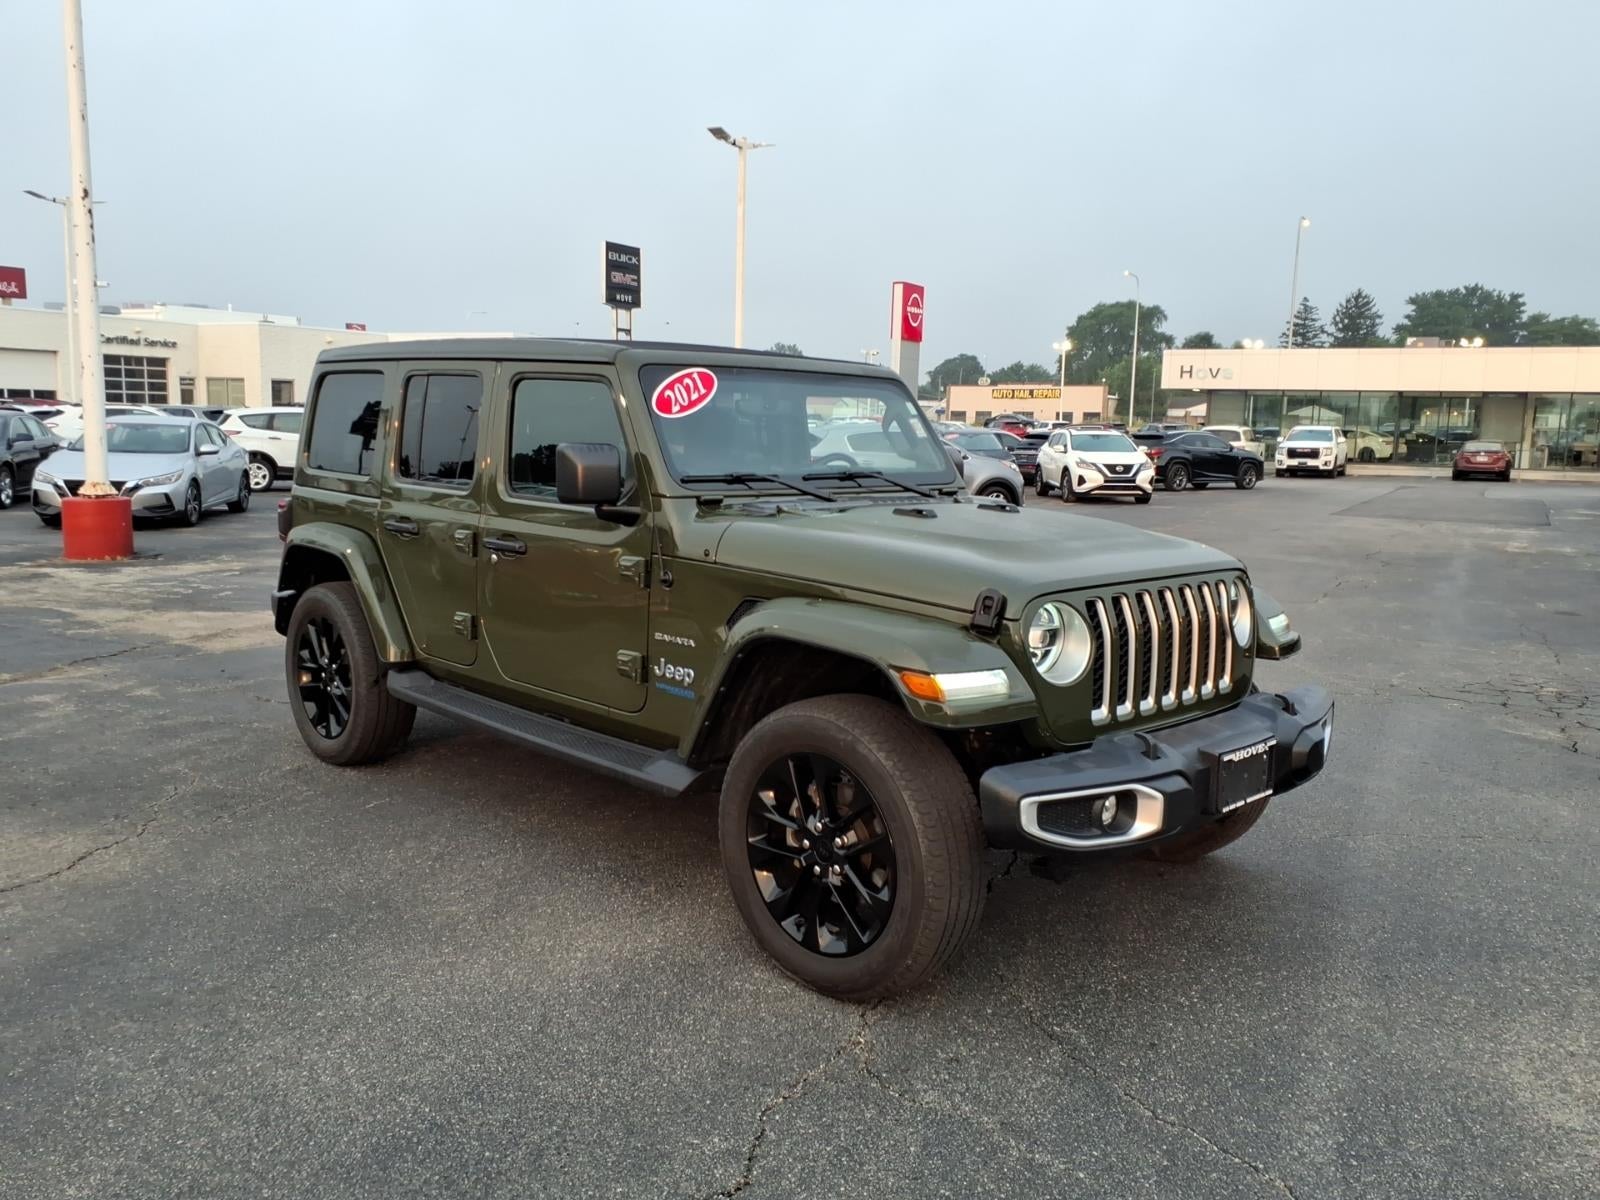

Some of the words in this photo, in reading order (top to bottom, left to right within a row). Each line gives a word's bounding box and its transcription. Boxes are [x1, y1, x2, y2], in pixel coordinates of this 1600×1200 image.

[608, 251, 639, 265] BUICK
[144, 337, 177, 348] Service
[664, 372, 707, 414] 2021
[992, 389, 1013, 398] AUTO
[1033, 389, 1061, 398] REPAIR
[653, 657, 695, 687] Jeep
